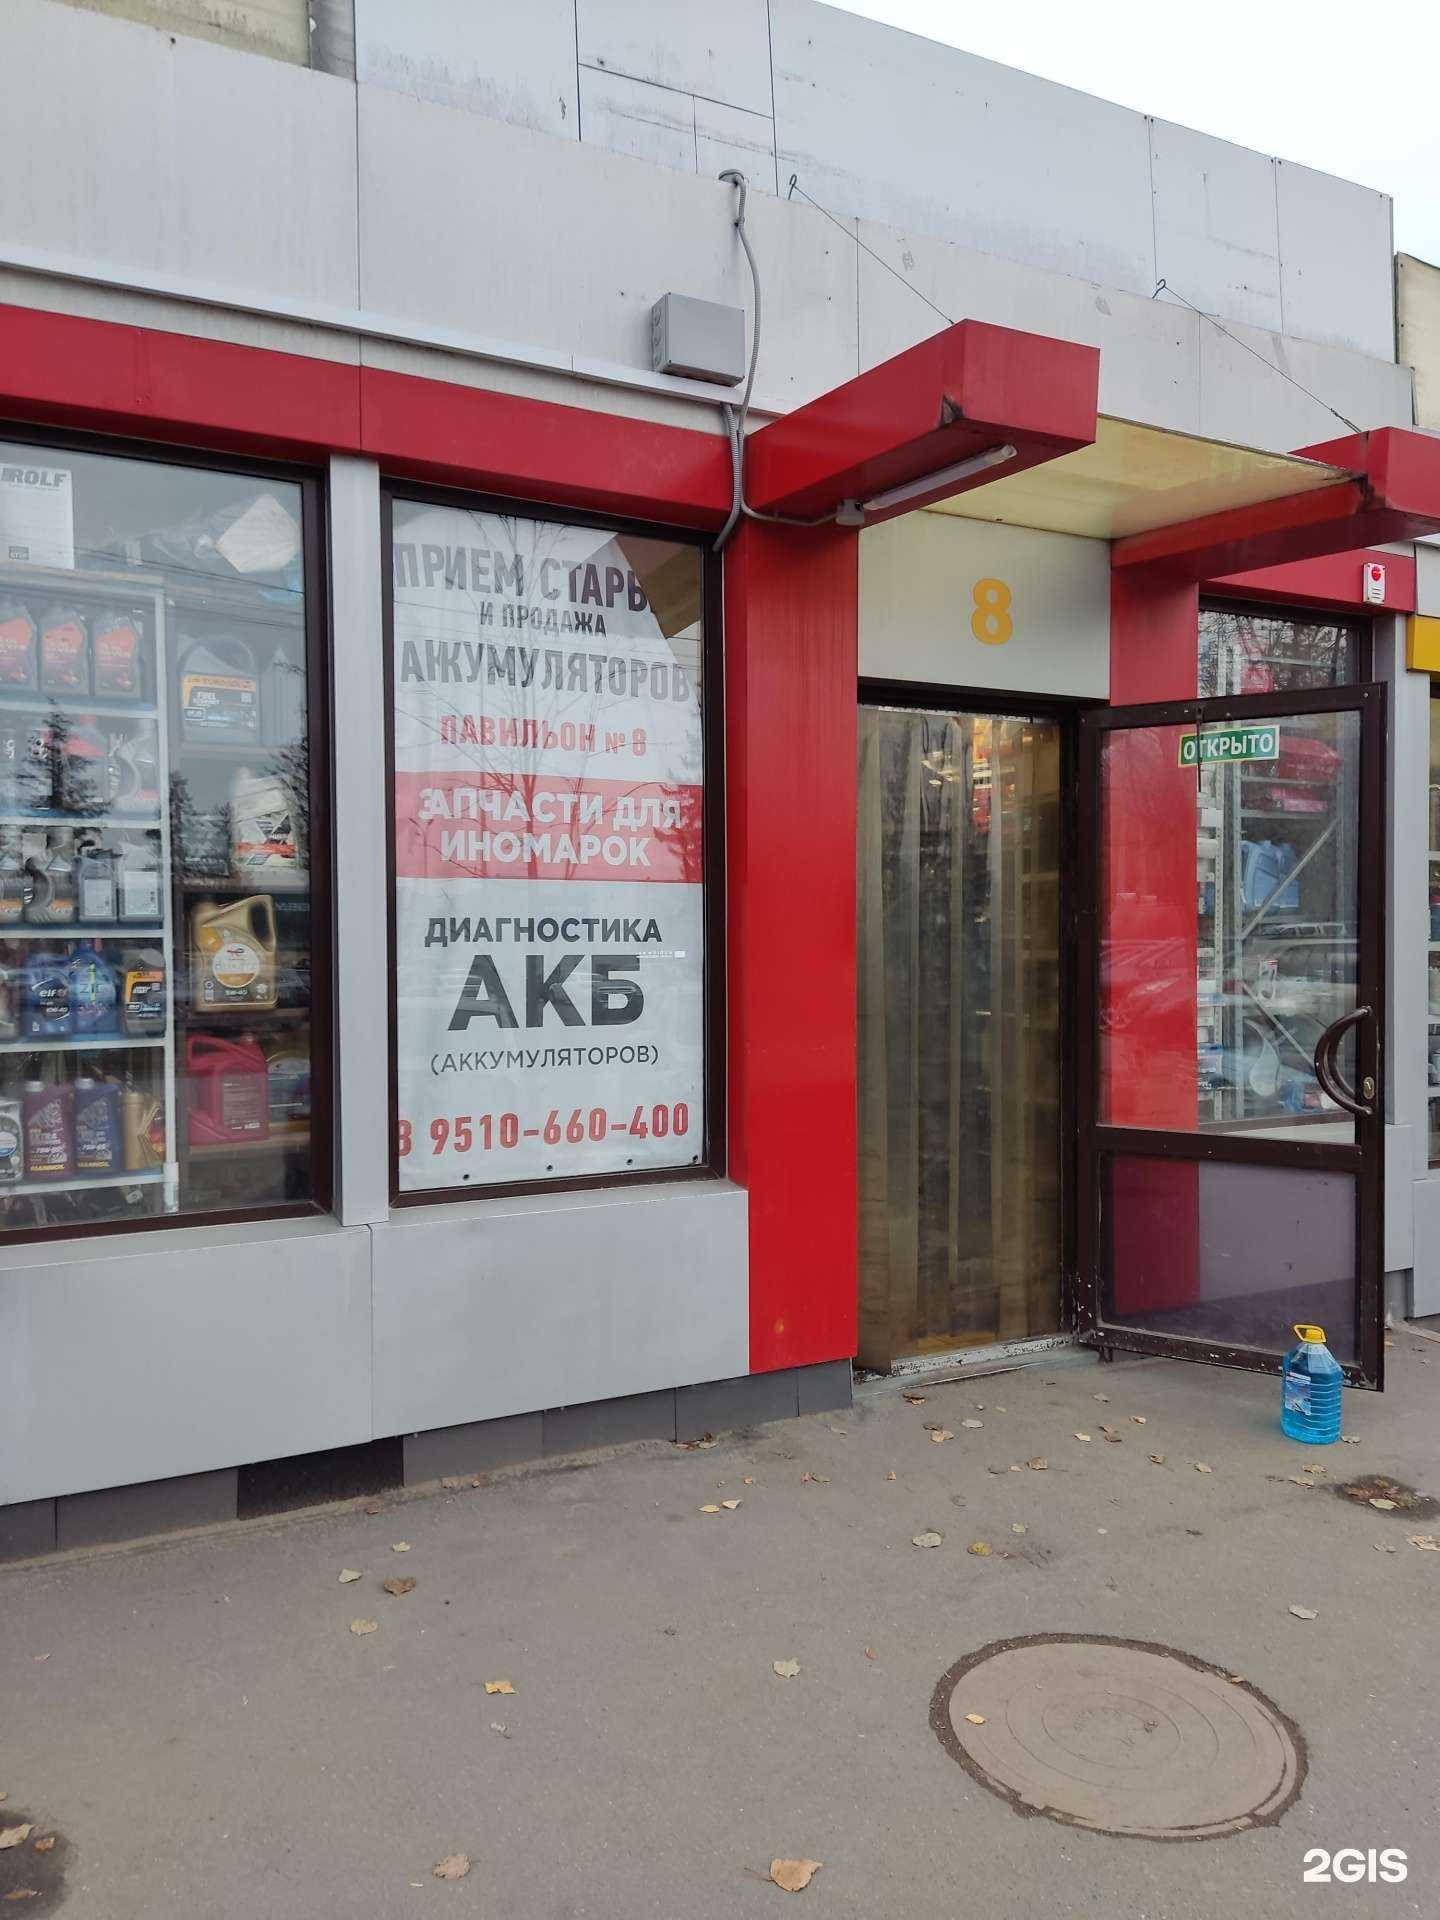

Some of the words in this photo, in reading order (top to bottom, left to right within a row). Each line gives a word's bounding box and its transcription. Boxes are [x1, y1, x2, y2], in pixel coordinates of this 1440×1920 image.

[2, 468, 66, 488] ROLF
[395, 542, 524, 597] ПРИЕМ
[480, 600, 494, 626] И
[502, 603, 607, 638] ПРОДАЖА
[970, 578, 1013, 645] 8
[400, 639, 691, 702] АККУМУЛЯТОРОВ
[440, 714, 596, 753] ПАВИЛЬОН
[632, 727, 647, 757] 8
[1183, 733, 1274, 760] ОТКРЫТО
[418, 787, 604, 825] ЗАПЧАСТИ
[612, 797, 684, 831] ДЛЯ
[440, 830, 651, 867] ИНОМАРОК
[424, 917, 663, 948] ДИАГНОСТИКА
[447, 954, 645, 1031] АКБ
[430, 1045, 660, 1077] (АККУМУЛЯТОРОВ)
[429, 1101, 690, 1156] 9510-660-400
